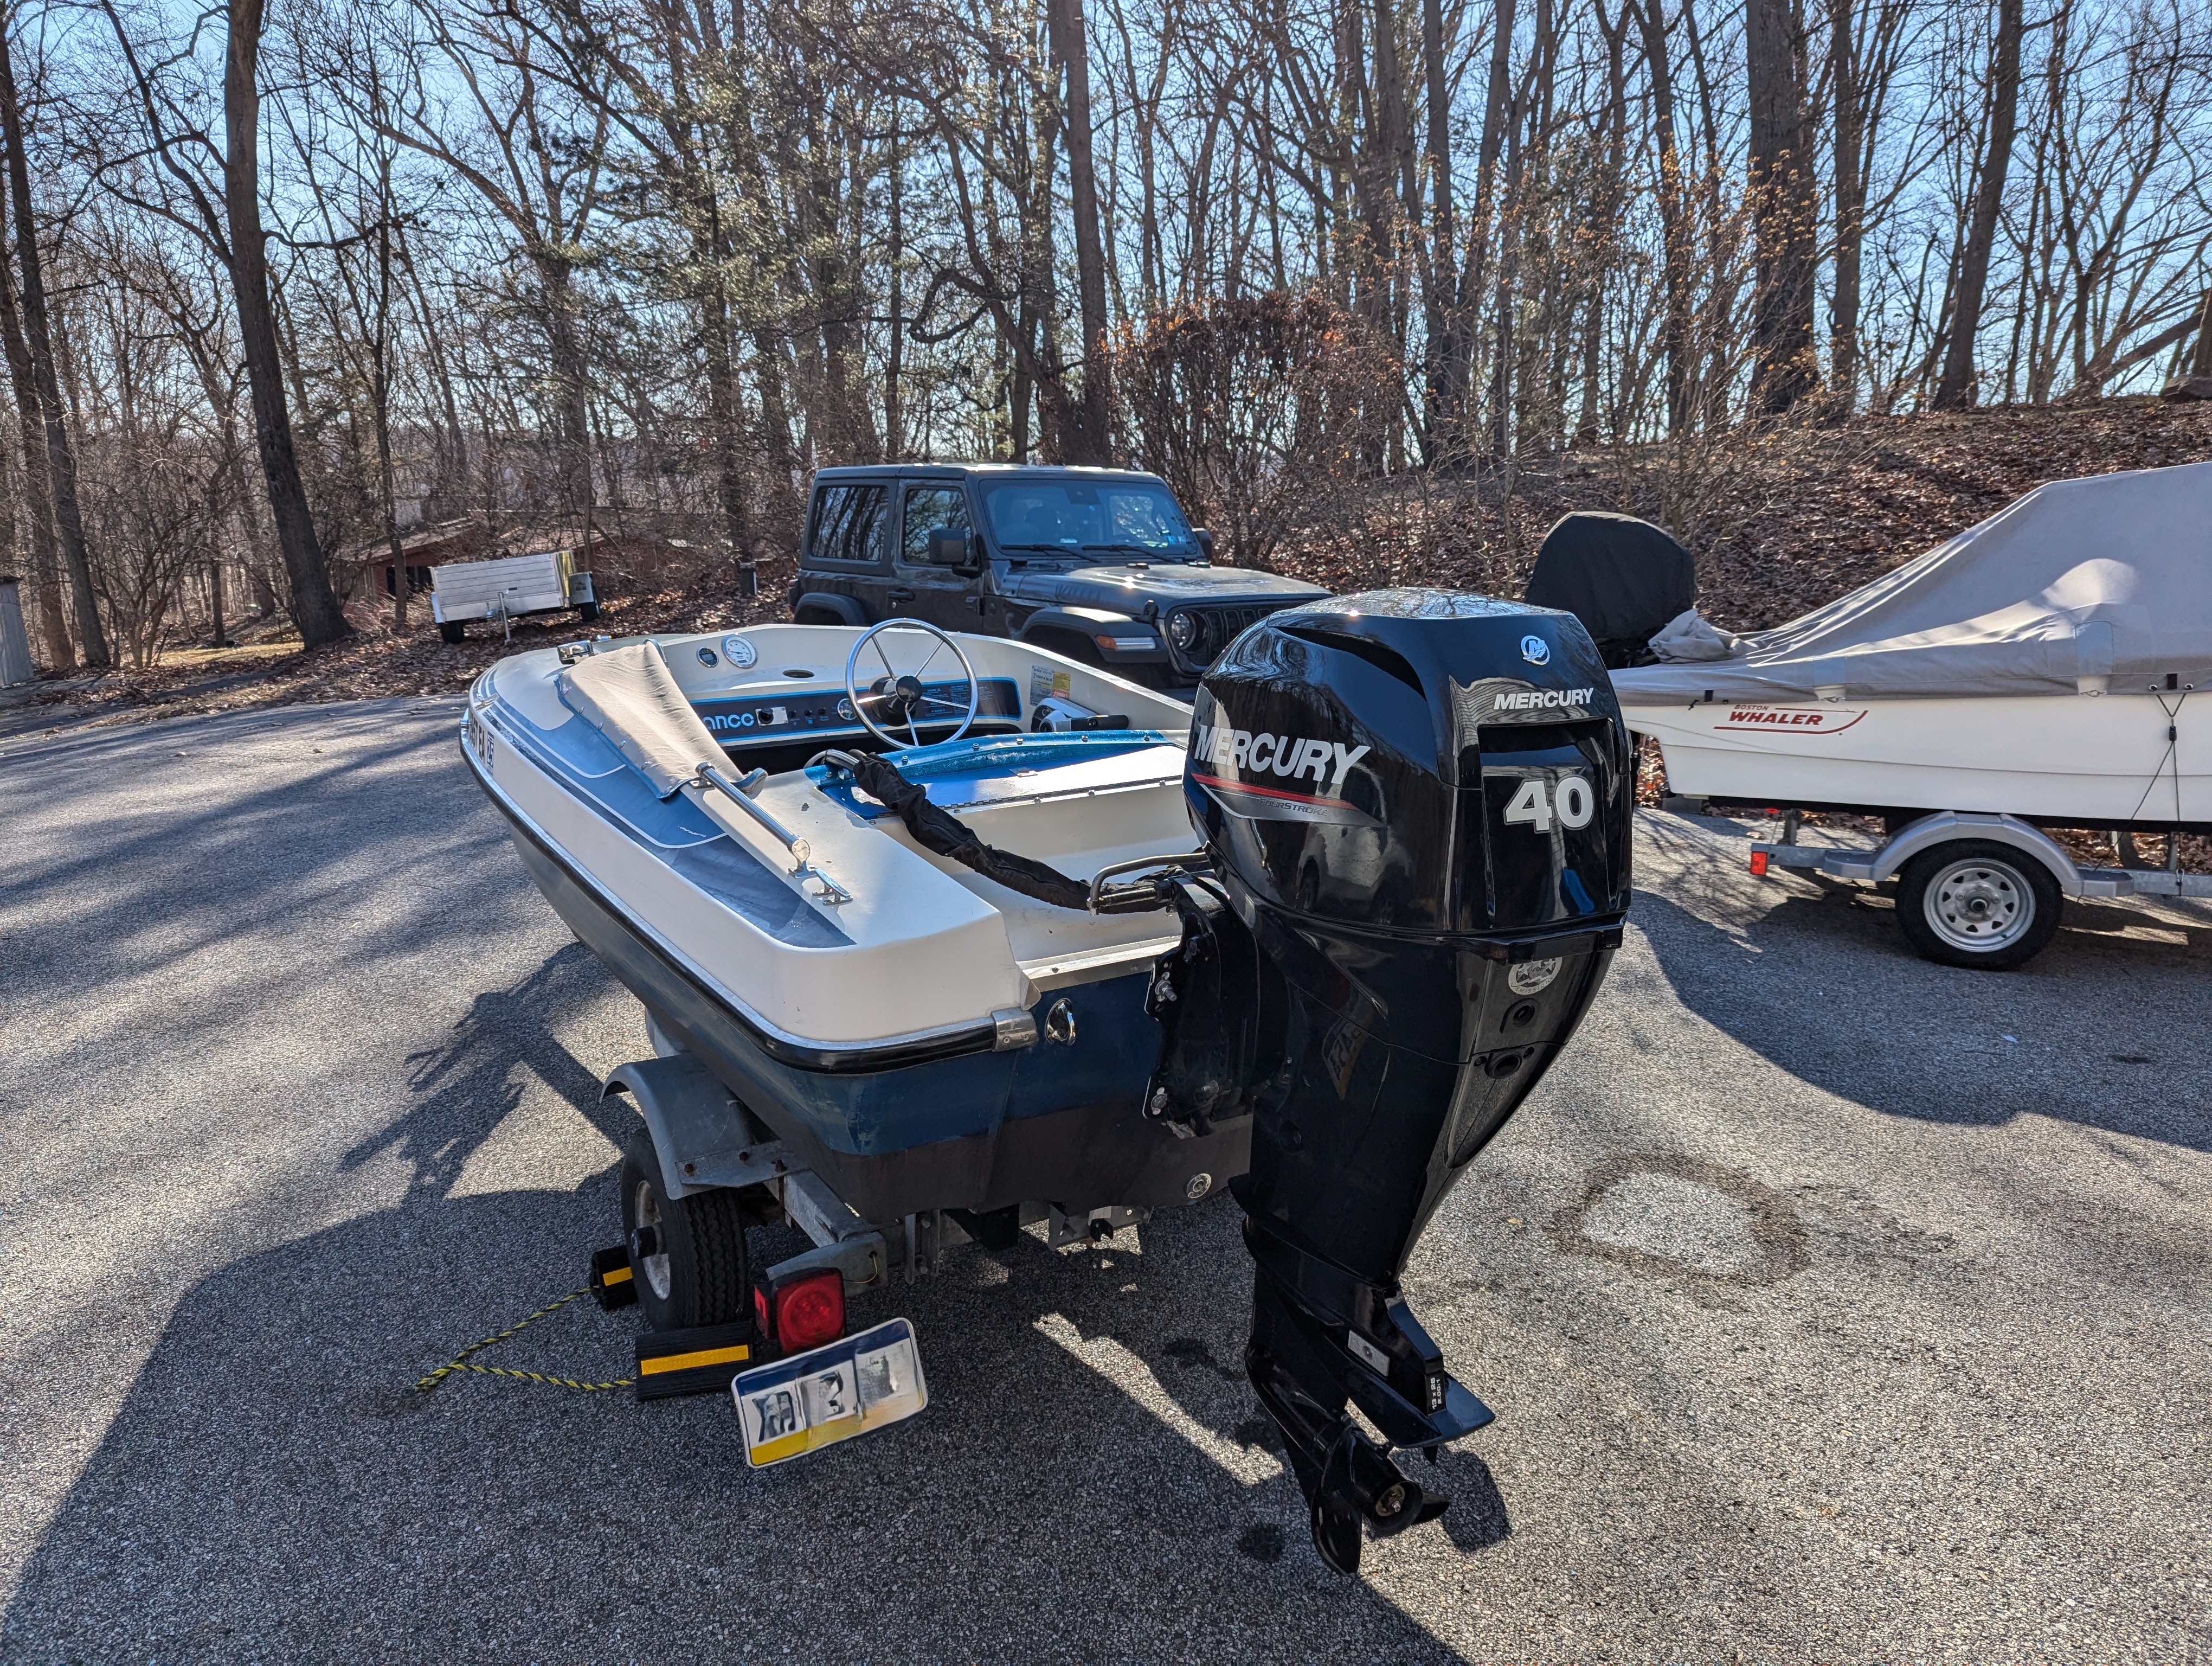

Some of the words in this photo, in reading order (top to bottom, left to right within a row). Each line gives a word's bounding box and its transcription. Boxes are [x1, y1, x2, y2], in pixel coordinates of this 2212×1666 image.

[1494, 688, 1594, 710] MERCURY
[1729, 712, 1823, 726] WHALER
[1194, 725, 1371, 785] MERCURY
[1503, 774, 1594, 833] 40
[1432, 1399, 1437, 1410] 13
